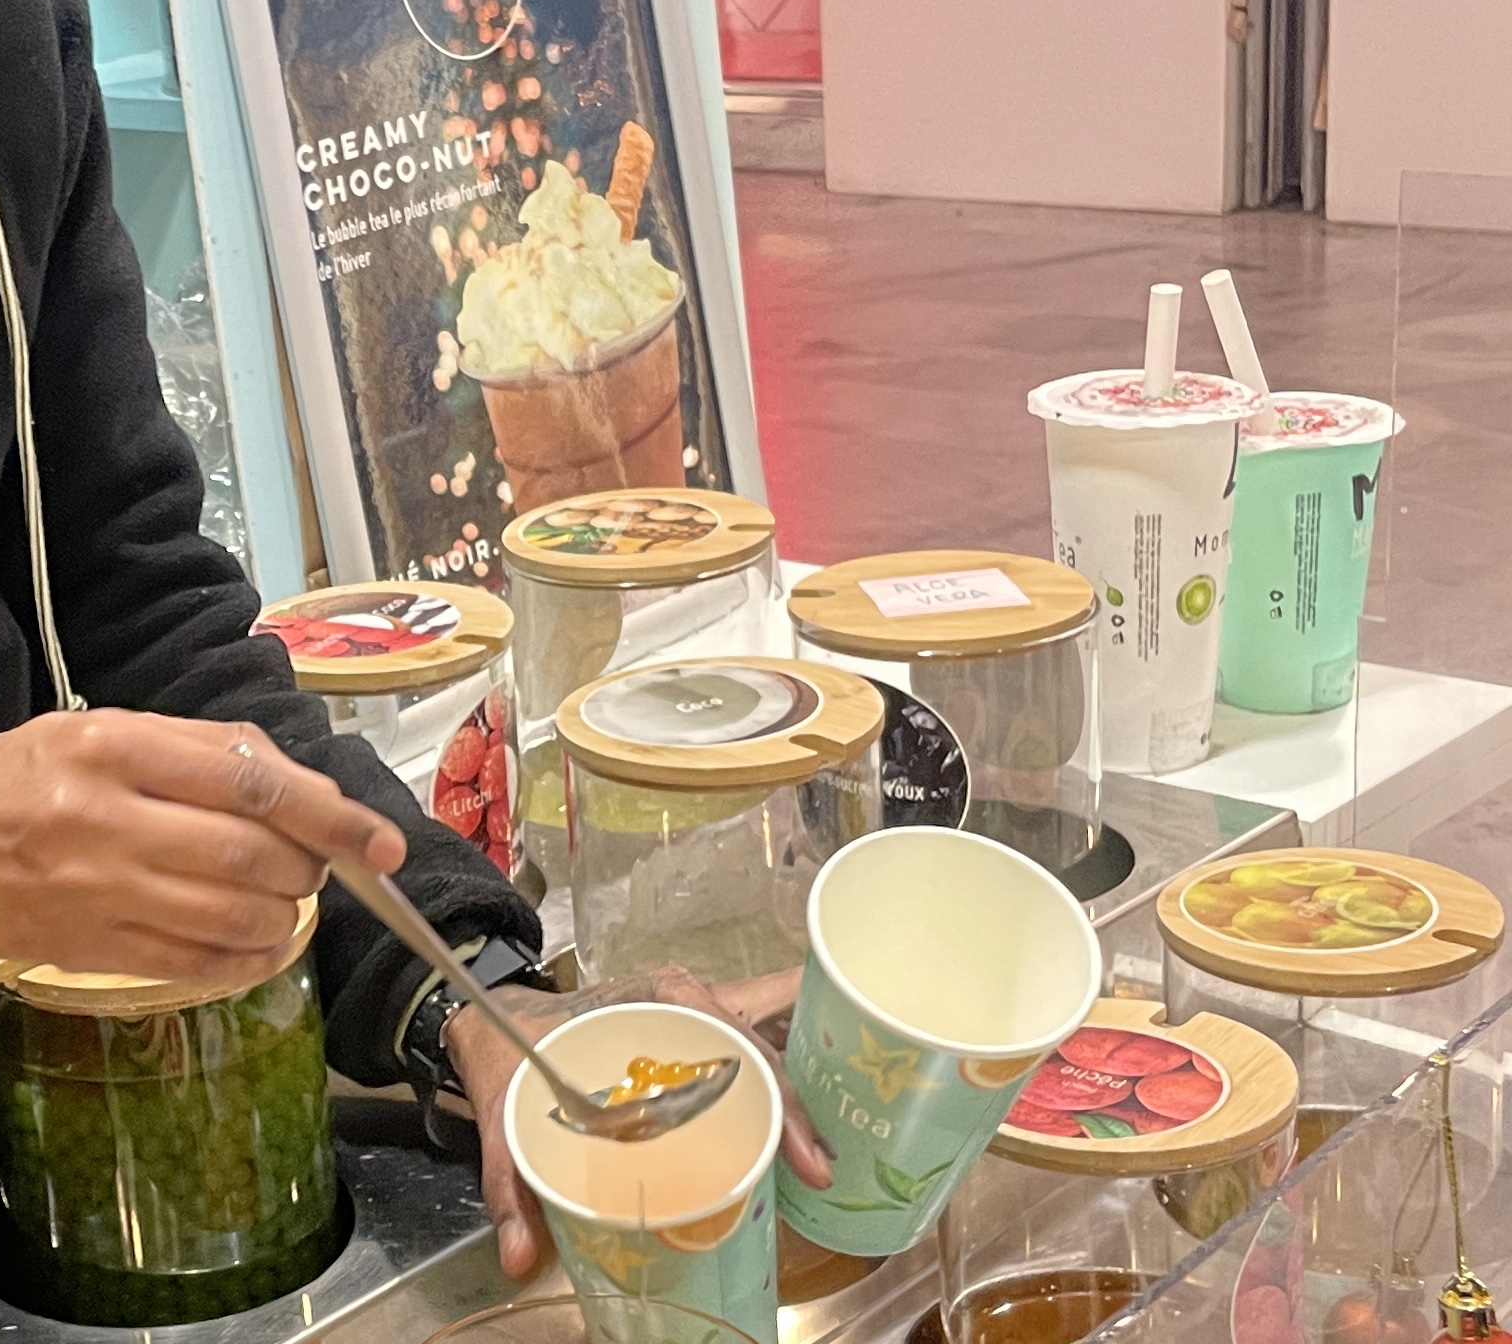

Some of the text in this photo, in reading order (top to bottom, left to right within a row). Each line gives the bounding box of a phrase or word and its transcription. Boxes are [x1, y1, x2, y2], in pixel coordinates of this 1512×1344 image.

[296, 110, 427, 173] CREAMY
[304, 131, 492, 212] CHOCO-NUT
[311, 232, 326, 251] Le
[326, 216, 367, 246] bubble
[368, 211, 389, 232] tea
[389, 206, 403, 225] le
[404, 199, 429, 227] plus
[317, 260, 333, 282] de
